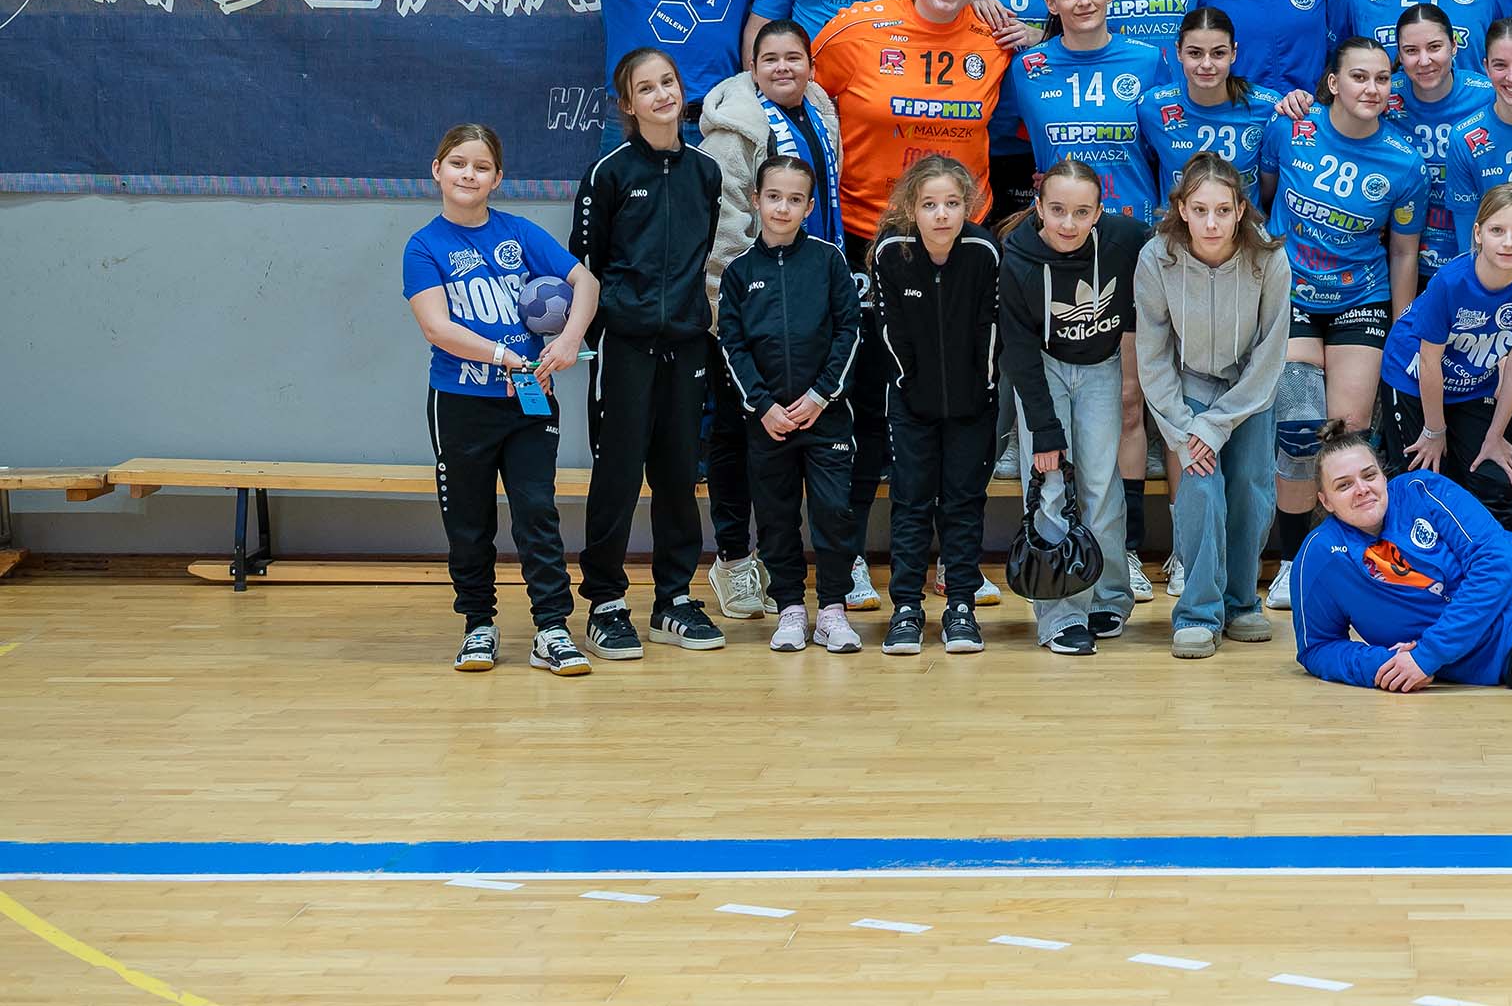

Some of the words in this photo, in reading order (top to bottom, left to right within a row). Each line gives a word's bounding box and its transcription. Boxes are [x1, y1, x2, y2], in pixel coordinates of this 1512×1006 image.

[655, 10, 689, 35] MISLENY
[889, 34, 909, 42] JAKO
[920, 50, 954, 85] 12
[1041, 90, 1063, 98] JAKO
[1065, 72, 1106, 108] 14
[914, 125, 975, 138] MAVASZK
[1414, 123, 1452, 159] 38
[1171, 140, 1193, 149] JAKO
[1197, 125, 1237, 162] 23
[1291, 158, 1315, 172] JAKO
[1313, 154, 1358, 198] 28
[1481, 167, 1503, 177] JAKO
[630, 189, 648, 198] JAKO
[748, 281, 765, 292] JAKO
[904, 288, 922, 297] JAKO
[1057, 314, 1121, 341] adidas
[1365, 326, 1386, 337] JAKO
